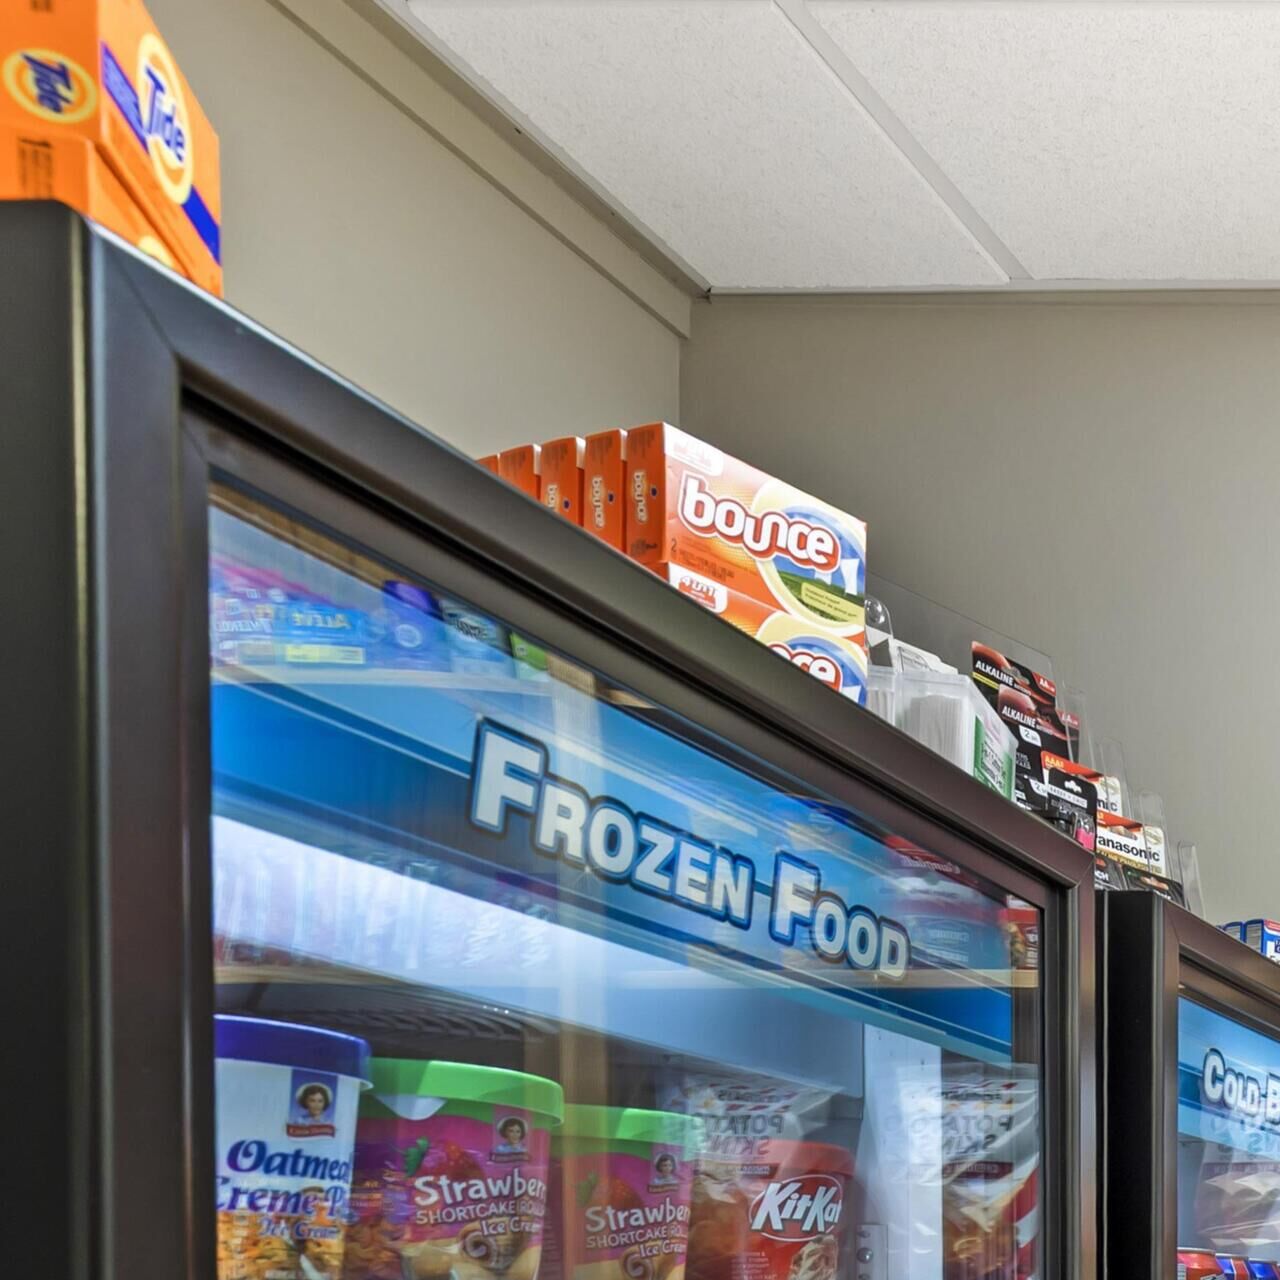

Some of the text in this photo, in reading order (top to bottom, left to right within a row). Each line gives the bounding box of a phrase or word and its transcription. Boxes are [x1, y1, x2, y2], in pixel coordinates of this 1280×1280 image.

[145, 65, 186, 163] Tide
[975, 660, 1015, 687] ALKALINE
[1001, 705, 1037, 728] ALKALINE
[1096, 834, 1161, 862] anasonic
